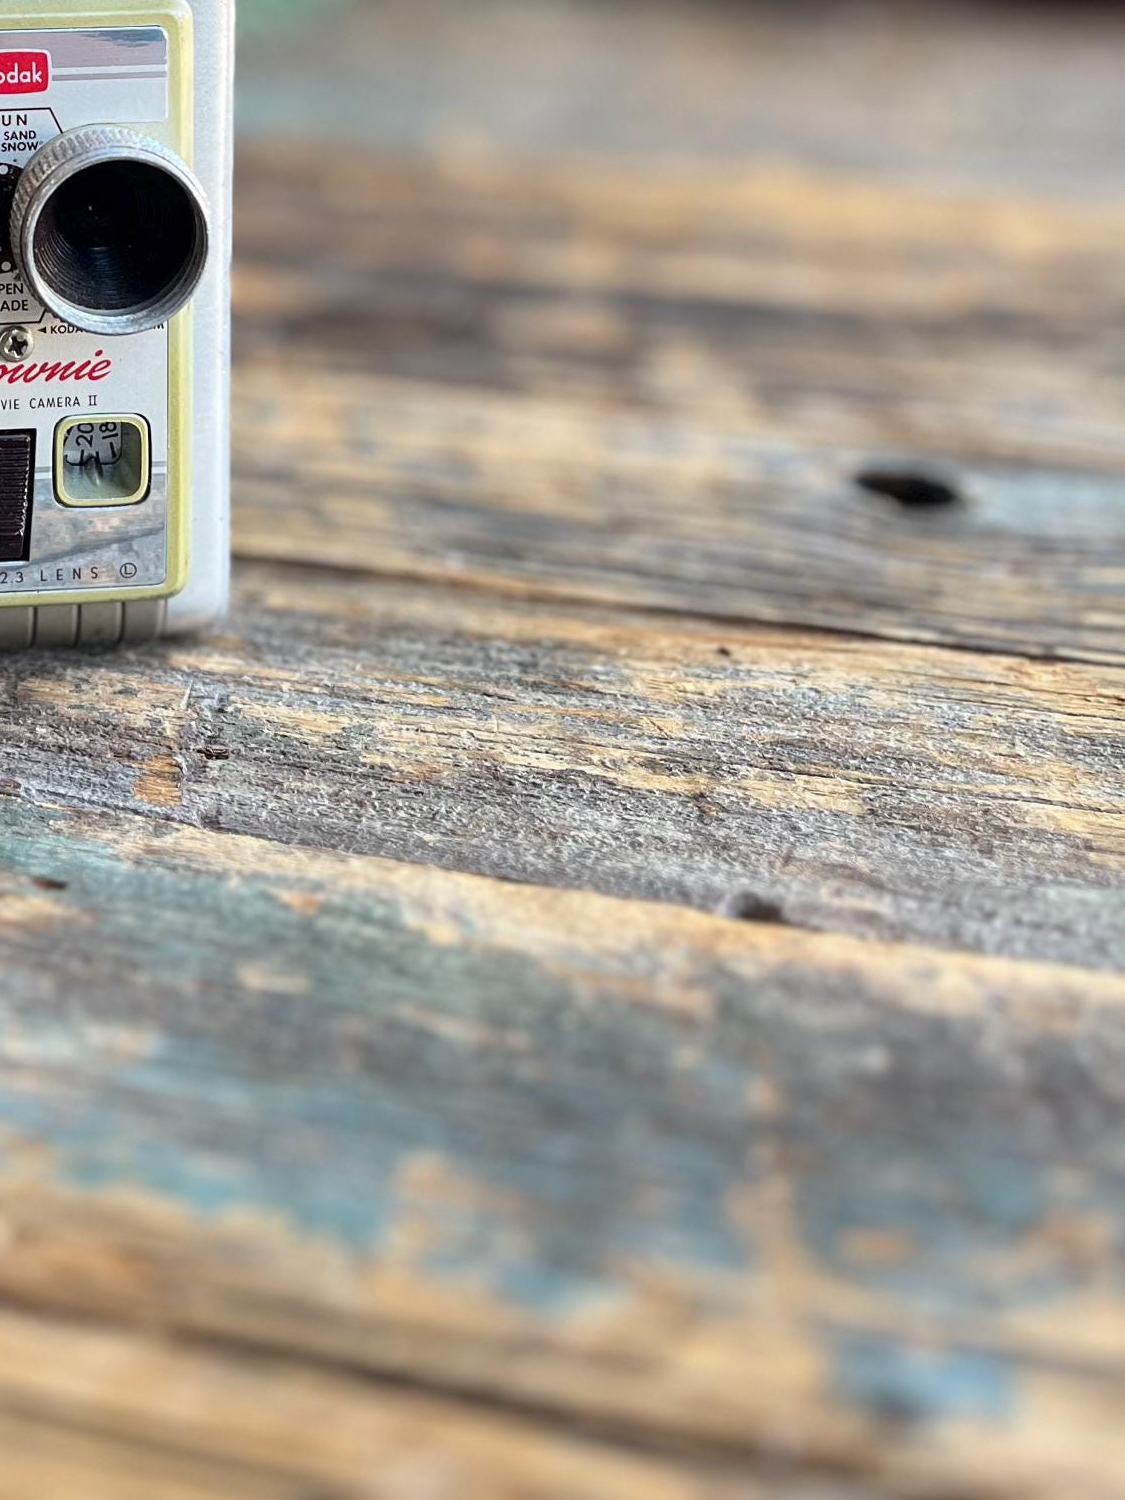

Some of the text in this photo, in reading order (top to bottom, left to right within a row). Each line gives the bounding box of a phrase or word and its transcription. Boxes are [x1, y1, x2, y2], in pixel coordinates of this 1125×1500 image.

[3, 130, 37, 141] SAND
[1, 141, 39, 153] SNOW
[29, 396, 81, 409] CAMERA
[40, 566, 99, 582] LENS
